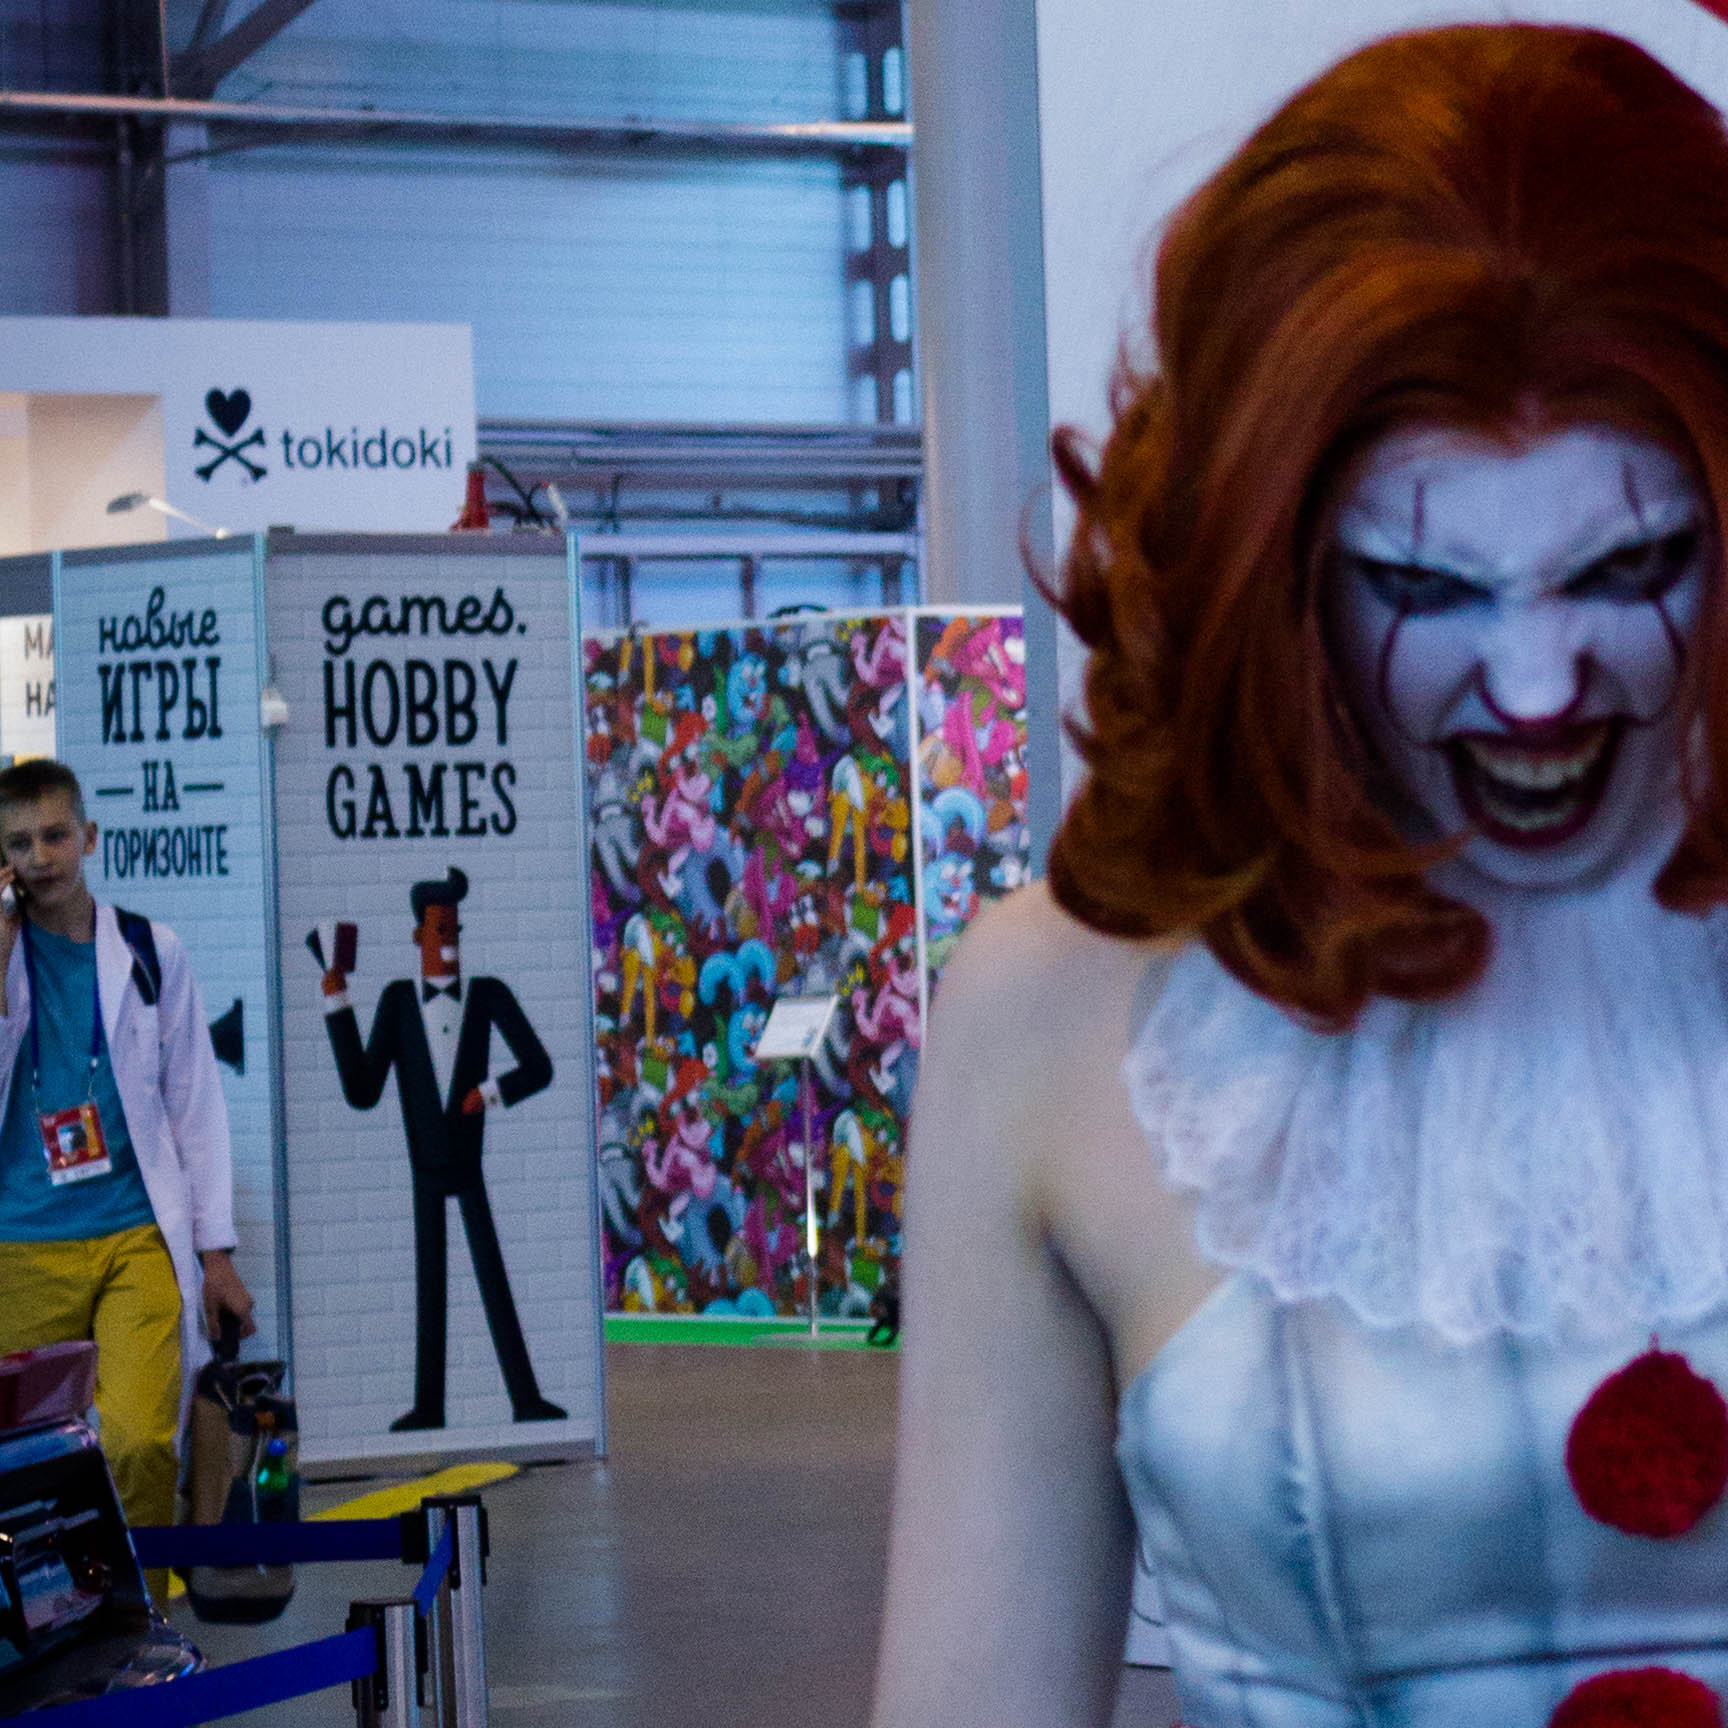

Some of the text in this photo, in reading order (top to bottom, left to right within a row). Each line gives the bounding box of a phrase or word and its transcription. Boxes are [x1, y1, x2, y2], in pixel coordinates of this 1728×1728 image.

[280, 427, 453, 468] tokidoki
[99, 586, 219, 653] новые
[98, 656, 223, 744] ИГРЫ
[323, 657, 519, 748] HOBBY
[325, 761, 518, 840] GAMES
[103, 824, 229, 880] ГОРИЗОНТЕ
